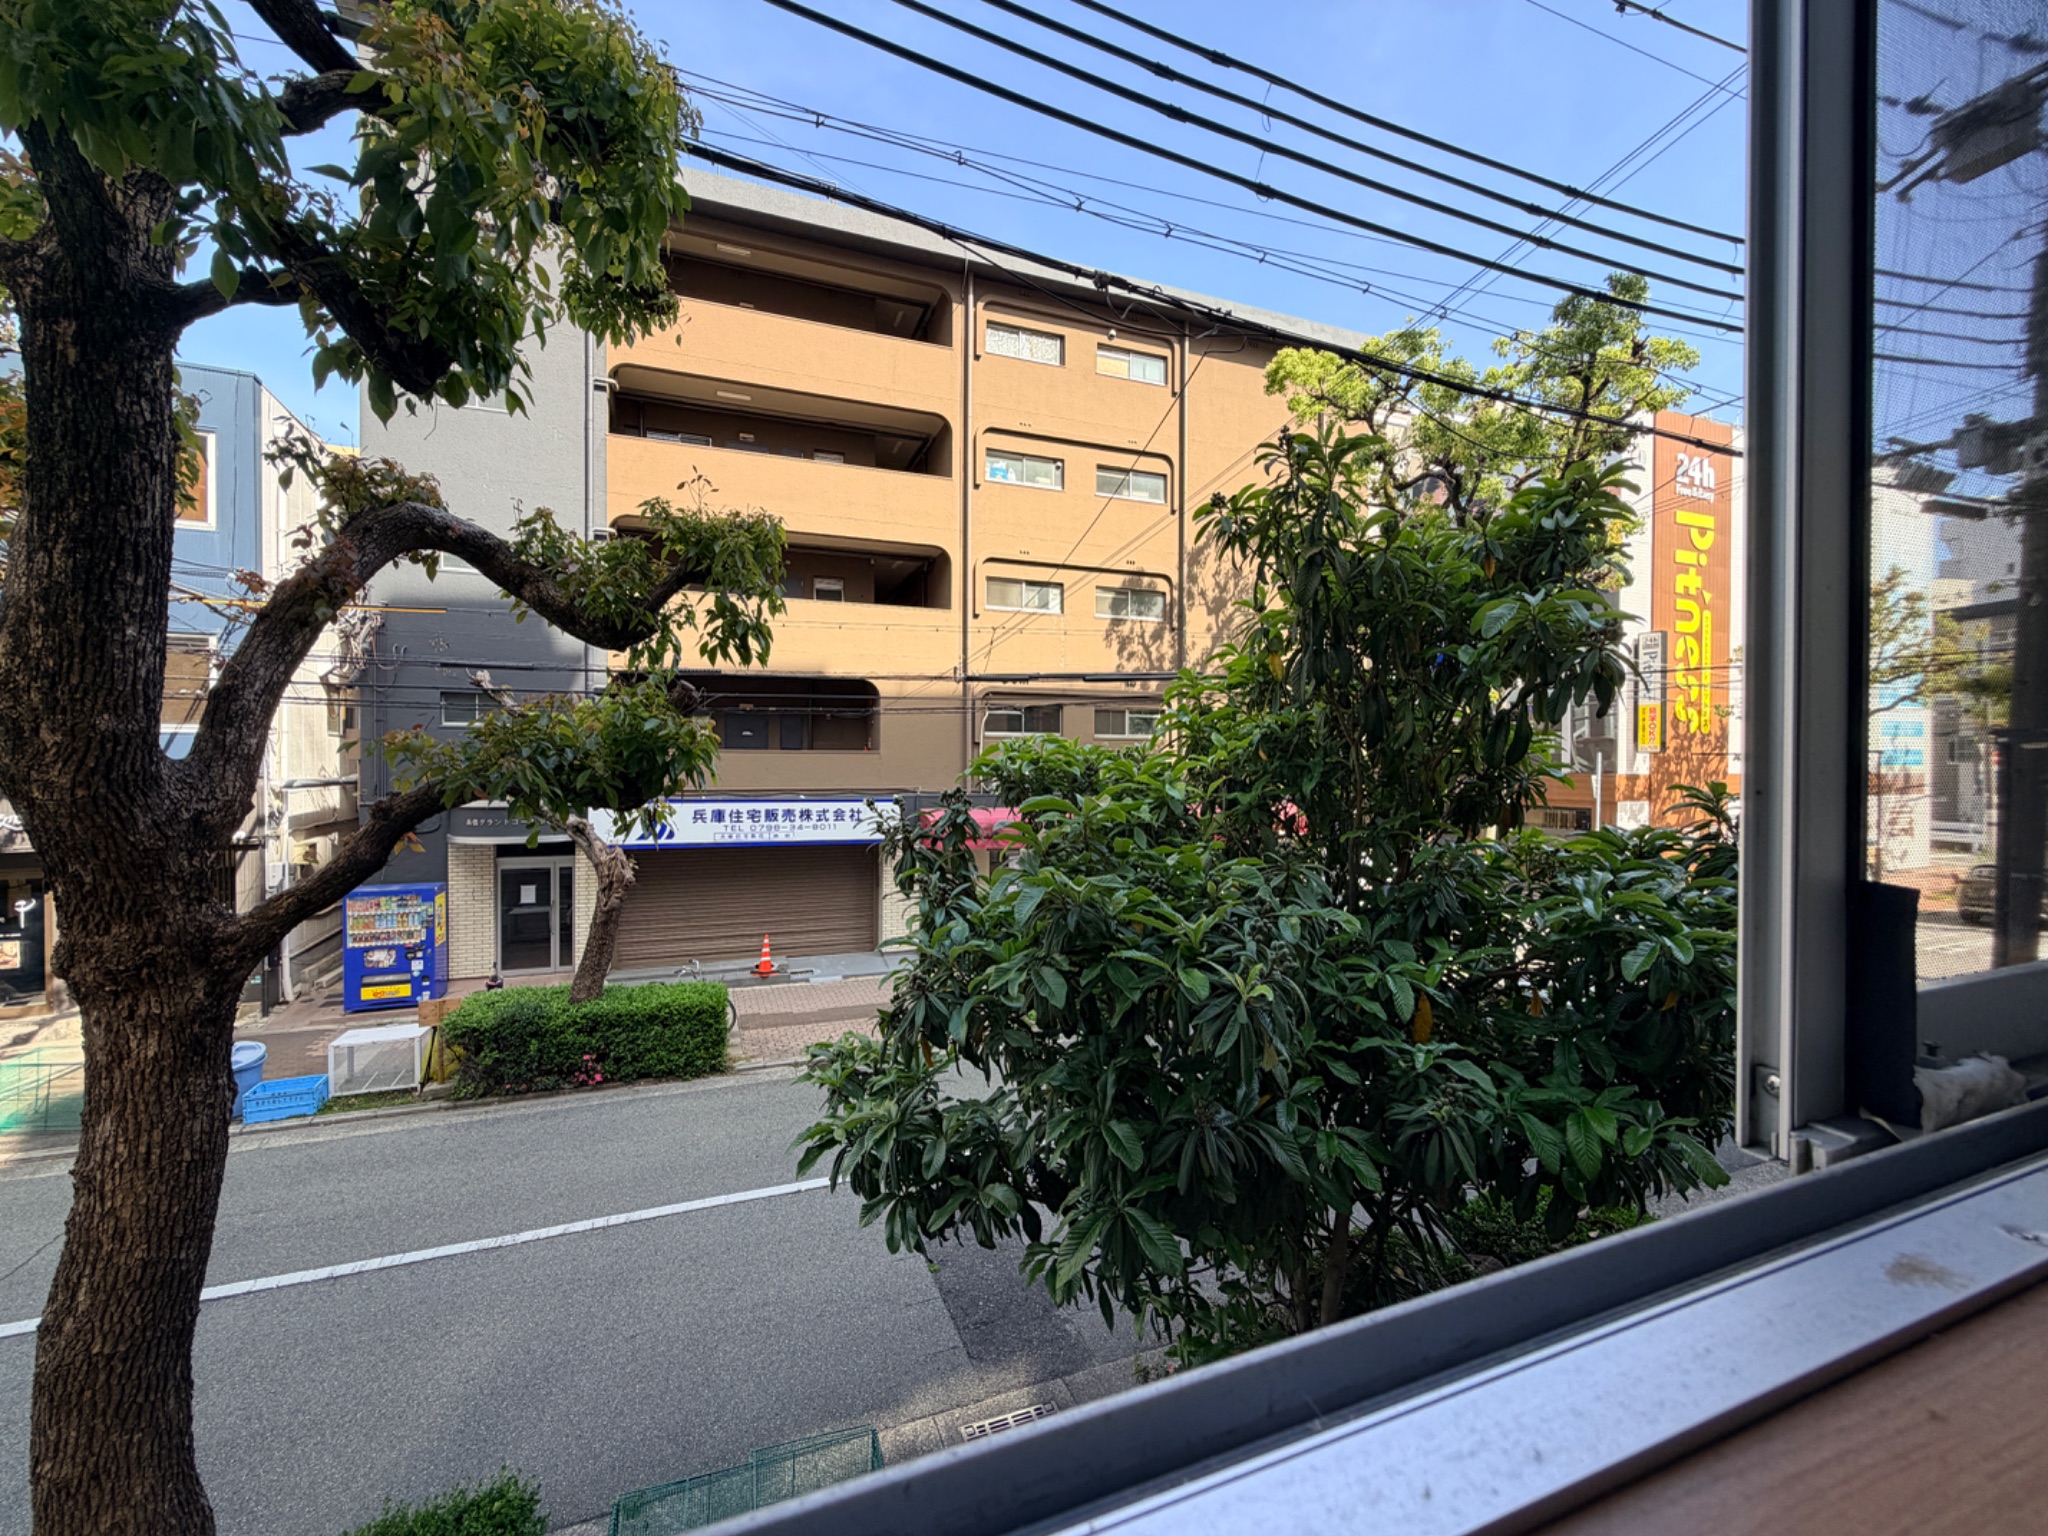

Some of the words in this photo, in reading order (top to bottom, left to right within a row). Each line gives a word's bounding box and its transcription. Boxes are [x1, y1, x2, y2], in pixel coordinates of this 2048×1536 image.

[1675, 452, 1715, 489] 24h
[692, 808, 863, 824] 兵庫住宅販売株式会社
